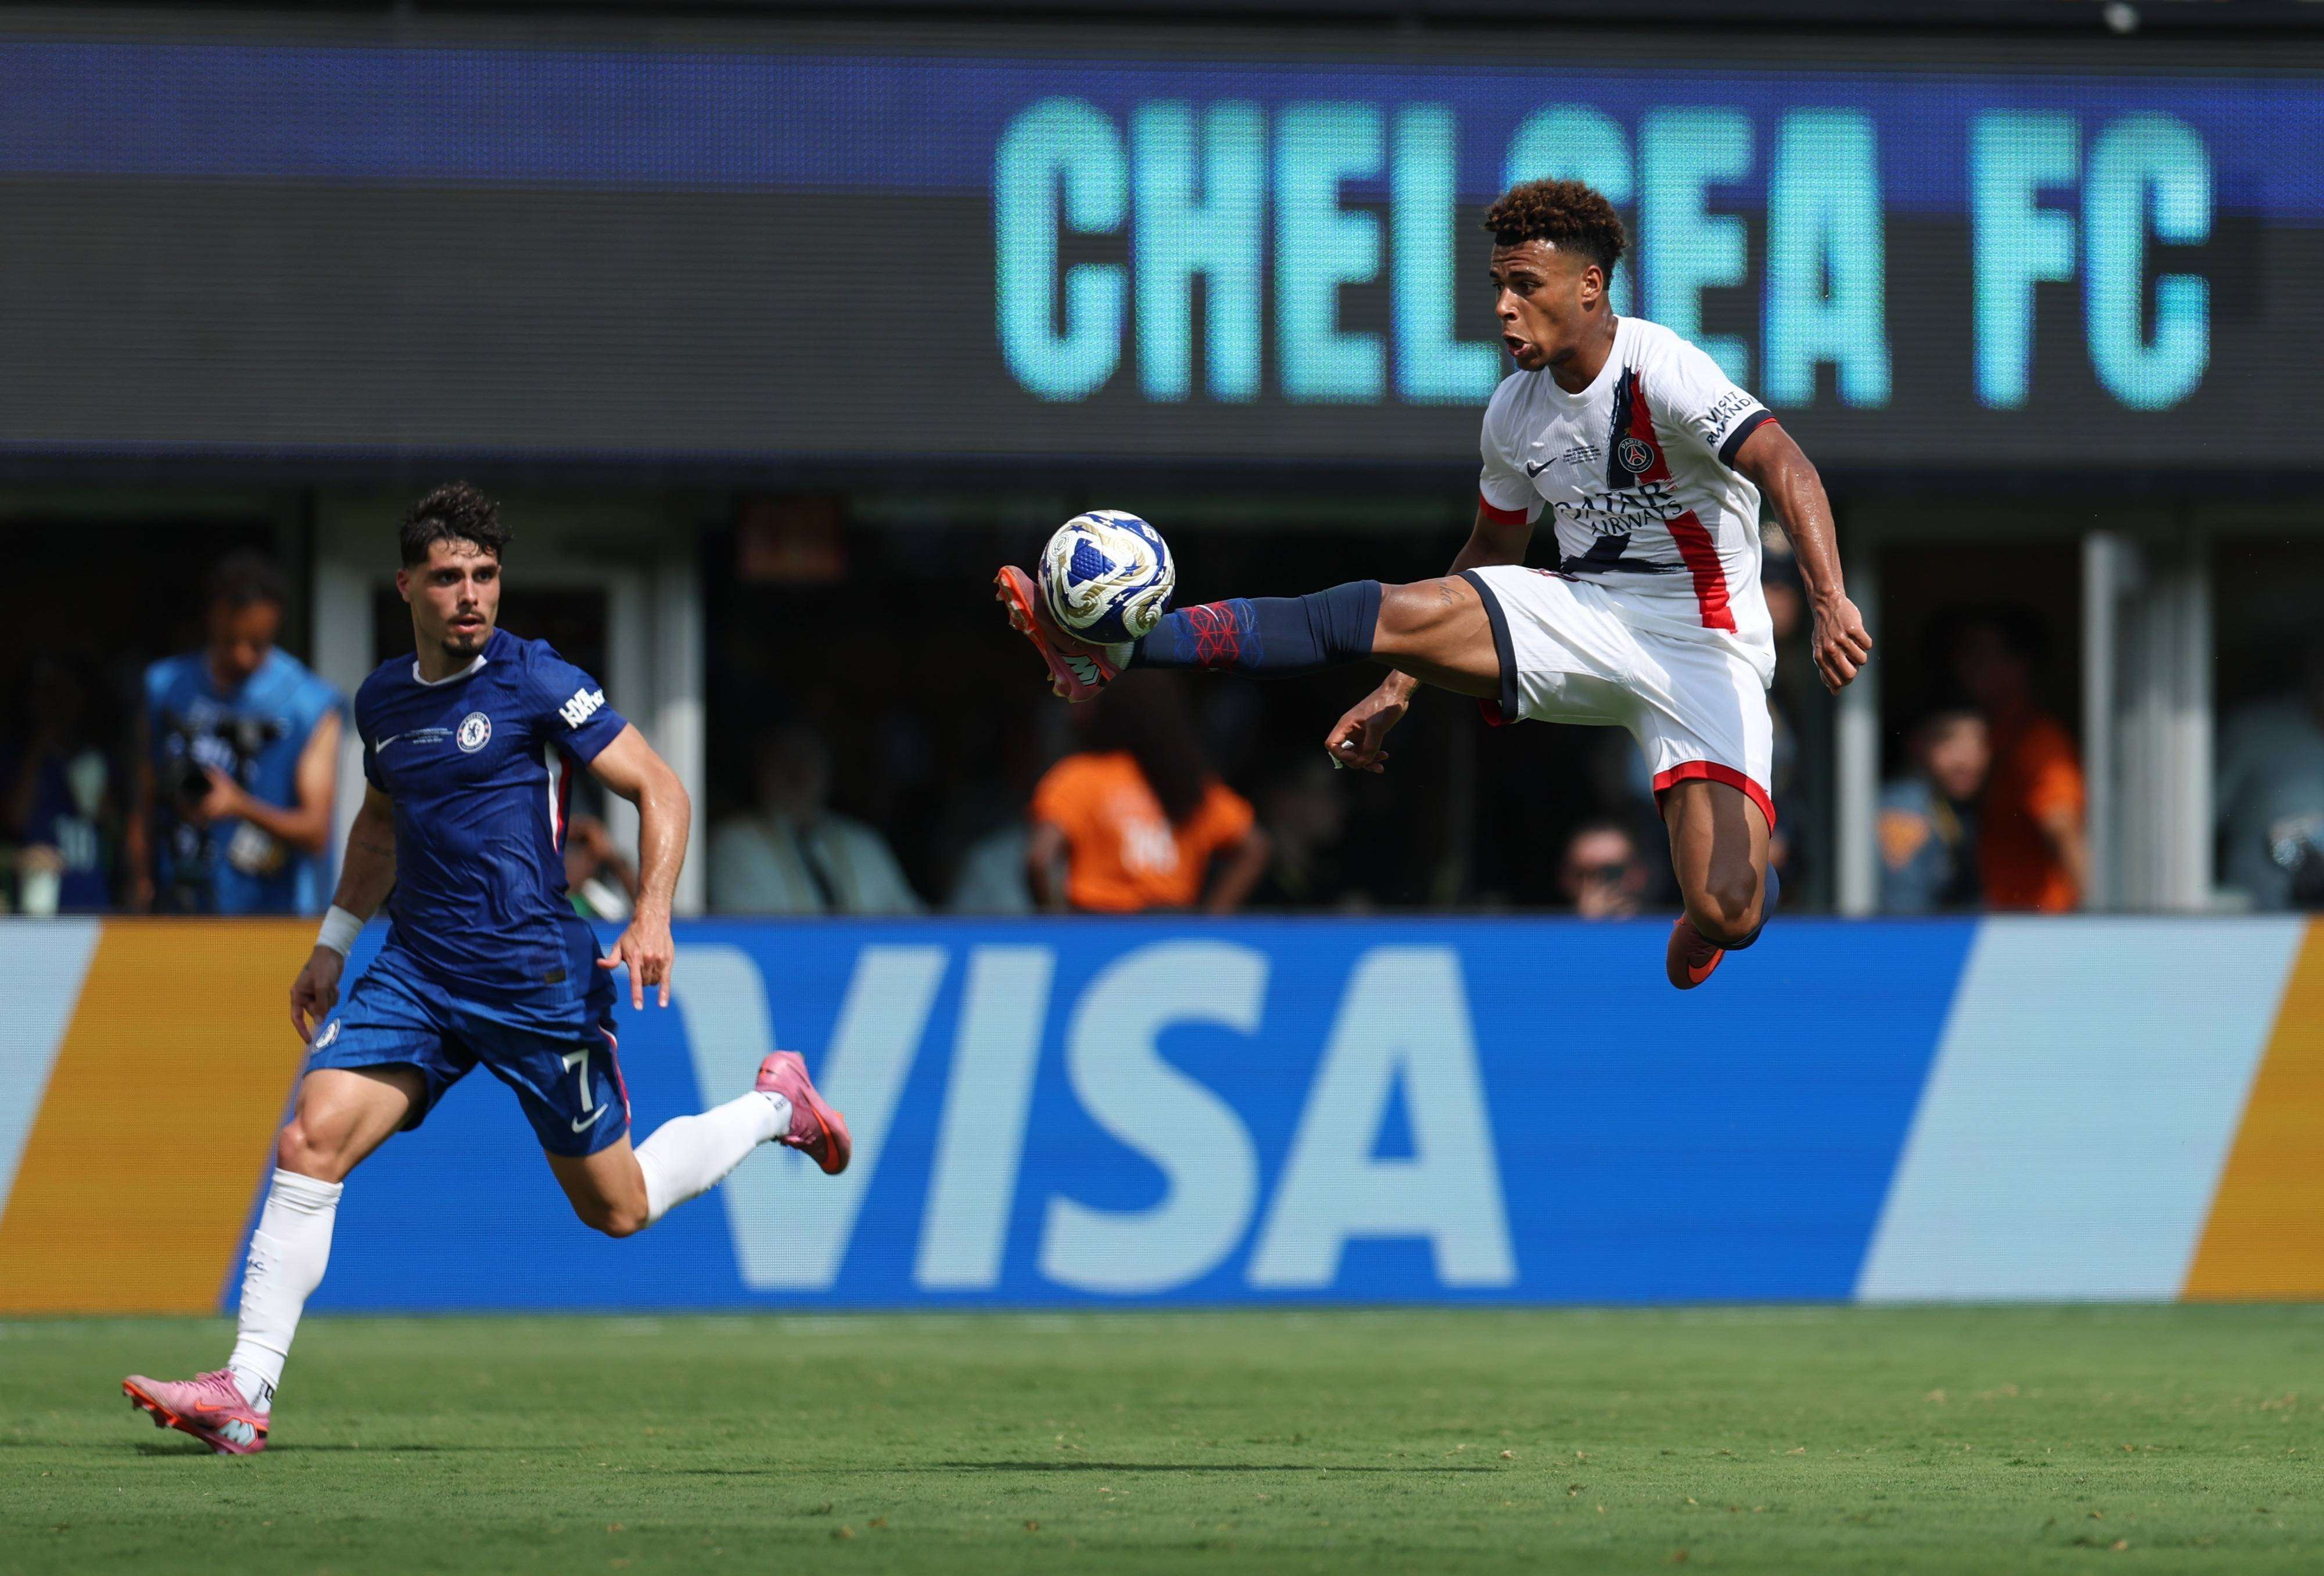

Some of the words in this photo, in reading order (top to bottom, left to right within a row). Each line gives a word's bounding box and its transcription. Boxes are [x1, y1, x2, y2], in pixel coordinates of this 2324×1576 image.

[1971, 109, 2211, 410] FC
[1706, 392, 1737, 423] VISIT
[1621, 439, 1642, 449] PARIS
[1592, 500, 1683, 535] AIRWAYS
[562, 1048, 594, 1113] 7
[600, 938, 1519, 1293] VISA
